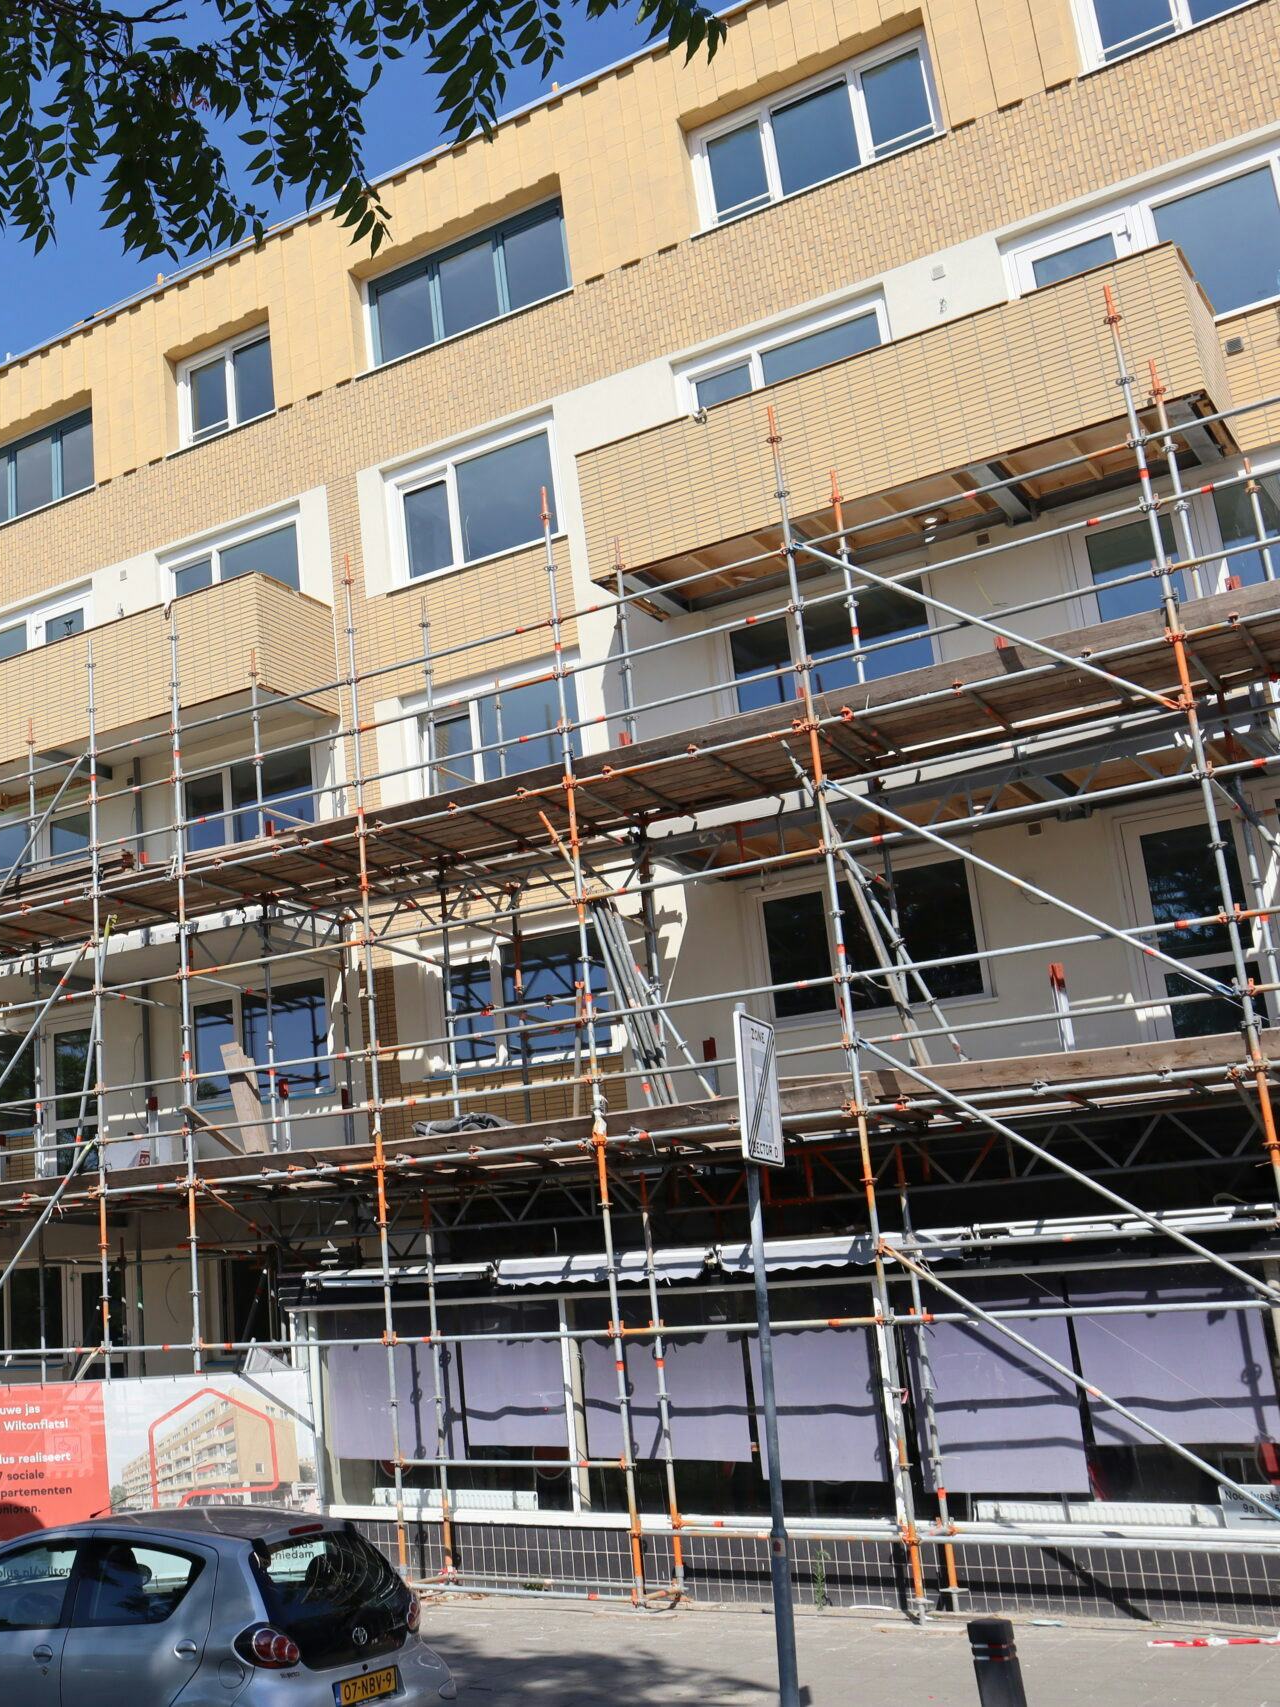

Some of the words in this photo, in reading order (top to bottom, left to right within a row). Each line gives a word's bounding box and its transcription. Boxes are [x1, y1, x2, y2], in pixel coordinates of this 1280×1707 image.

[750, 1027, 765, 1044] ZONE
[753, 1141, 772, 1156] SECTOR
[25, 1403, 41, 1416] jas
[3, 1418, 69, 1431] Wiltonflats!
[18, 1452, 72, 1464] realiseert
[7, 1469, 45, 1481] sociale
[271, 1550, 315, 1560] chiedam
[344, 1672, 393, 1701] 07-NBV-9
